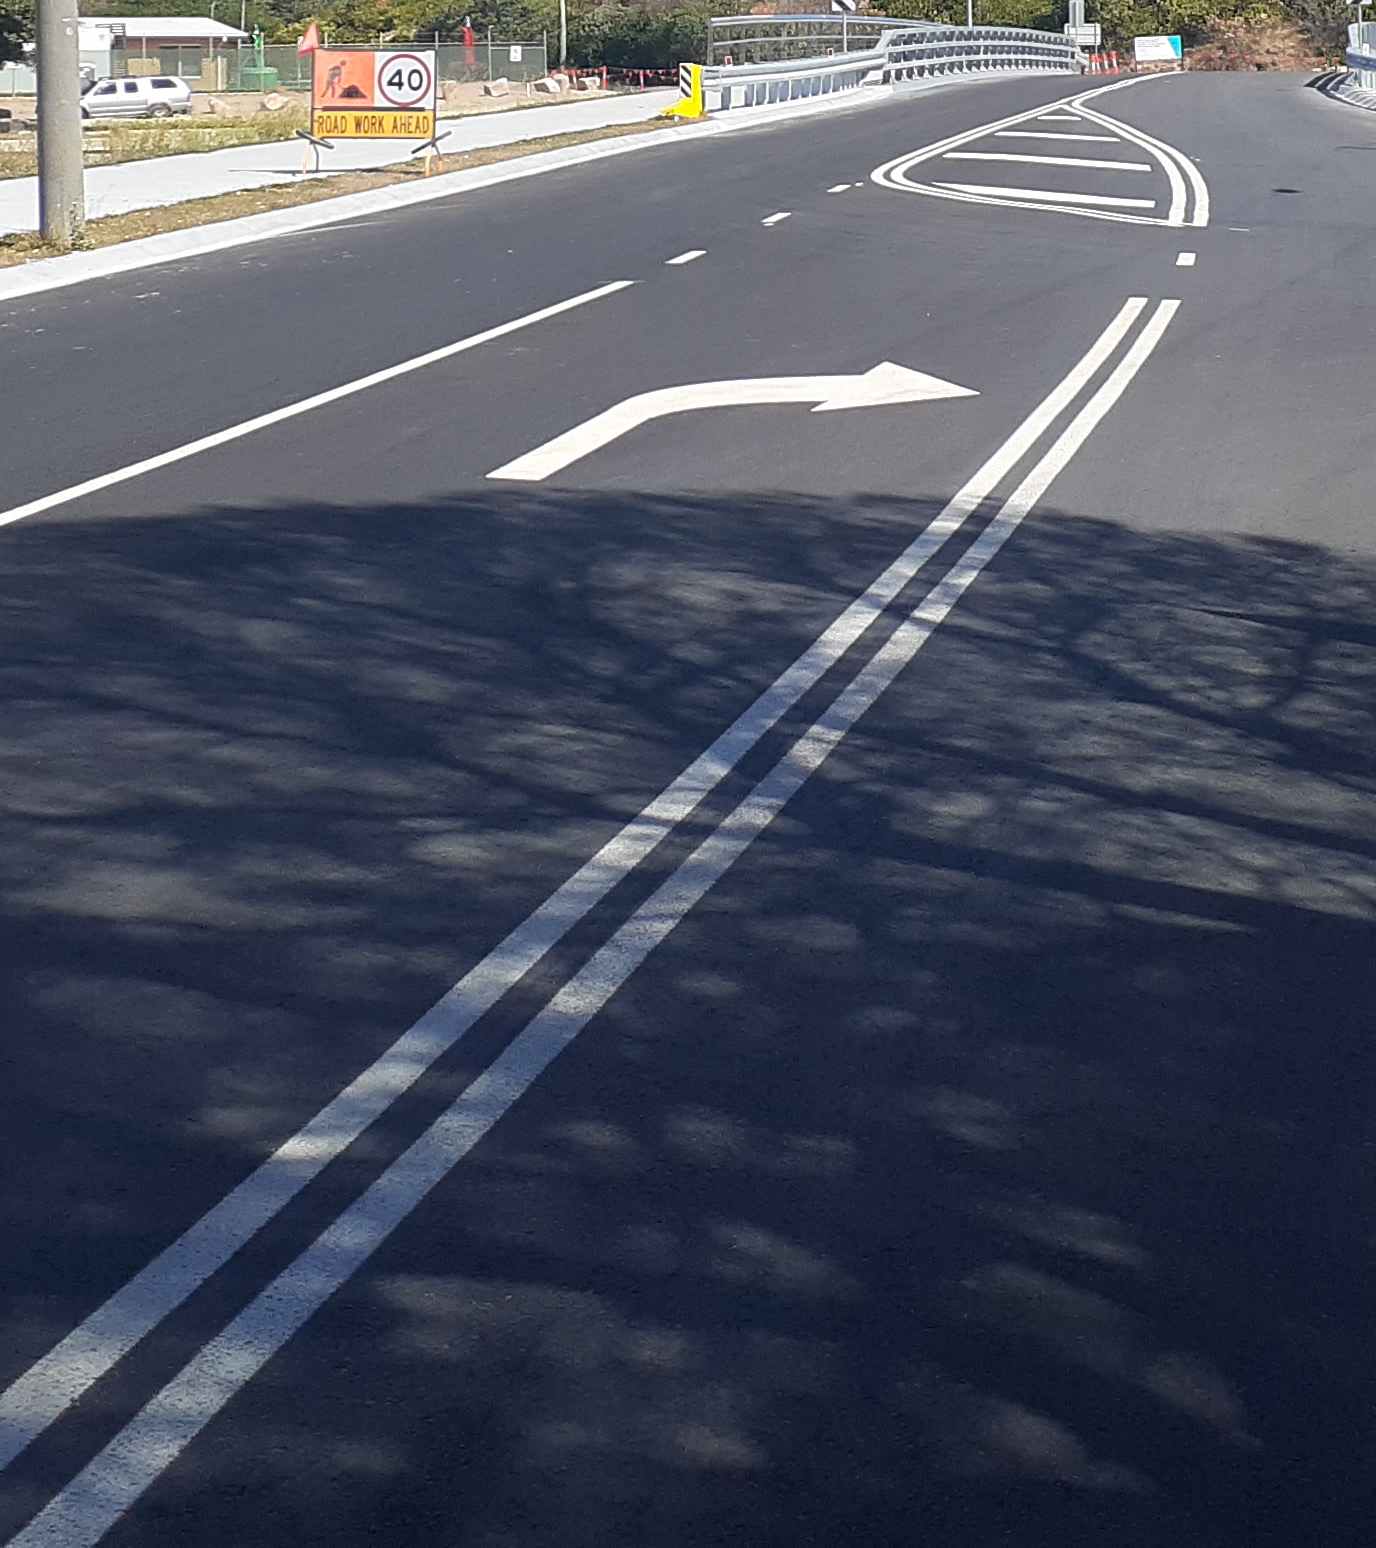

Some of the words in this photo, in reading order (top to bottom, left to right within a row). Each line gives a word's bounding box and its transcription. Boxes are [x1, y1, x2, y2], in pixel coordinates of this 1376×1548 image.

[386, 68, 423, 91] 40
[317, 115, 348, 134] ROAD
[354, 115, 385, 134] WORK
[391, 115, 430, 134] AHEAD
